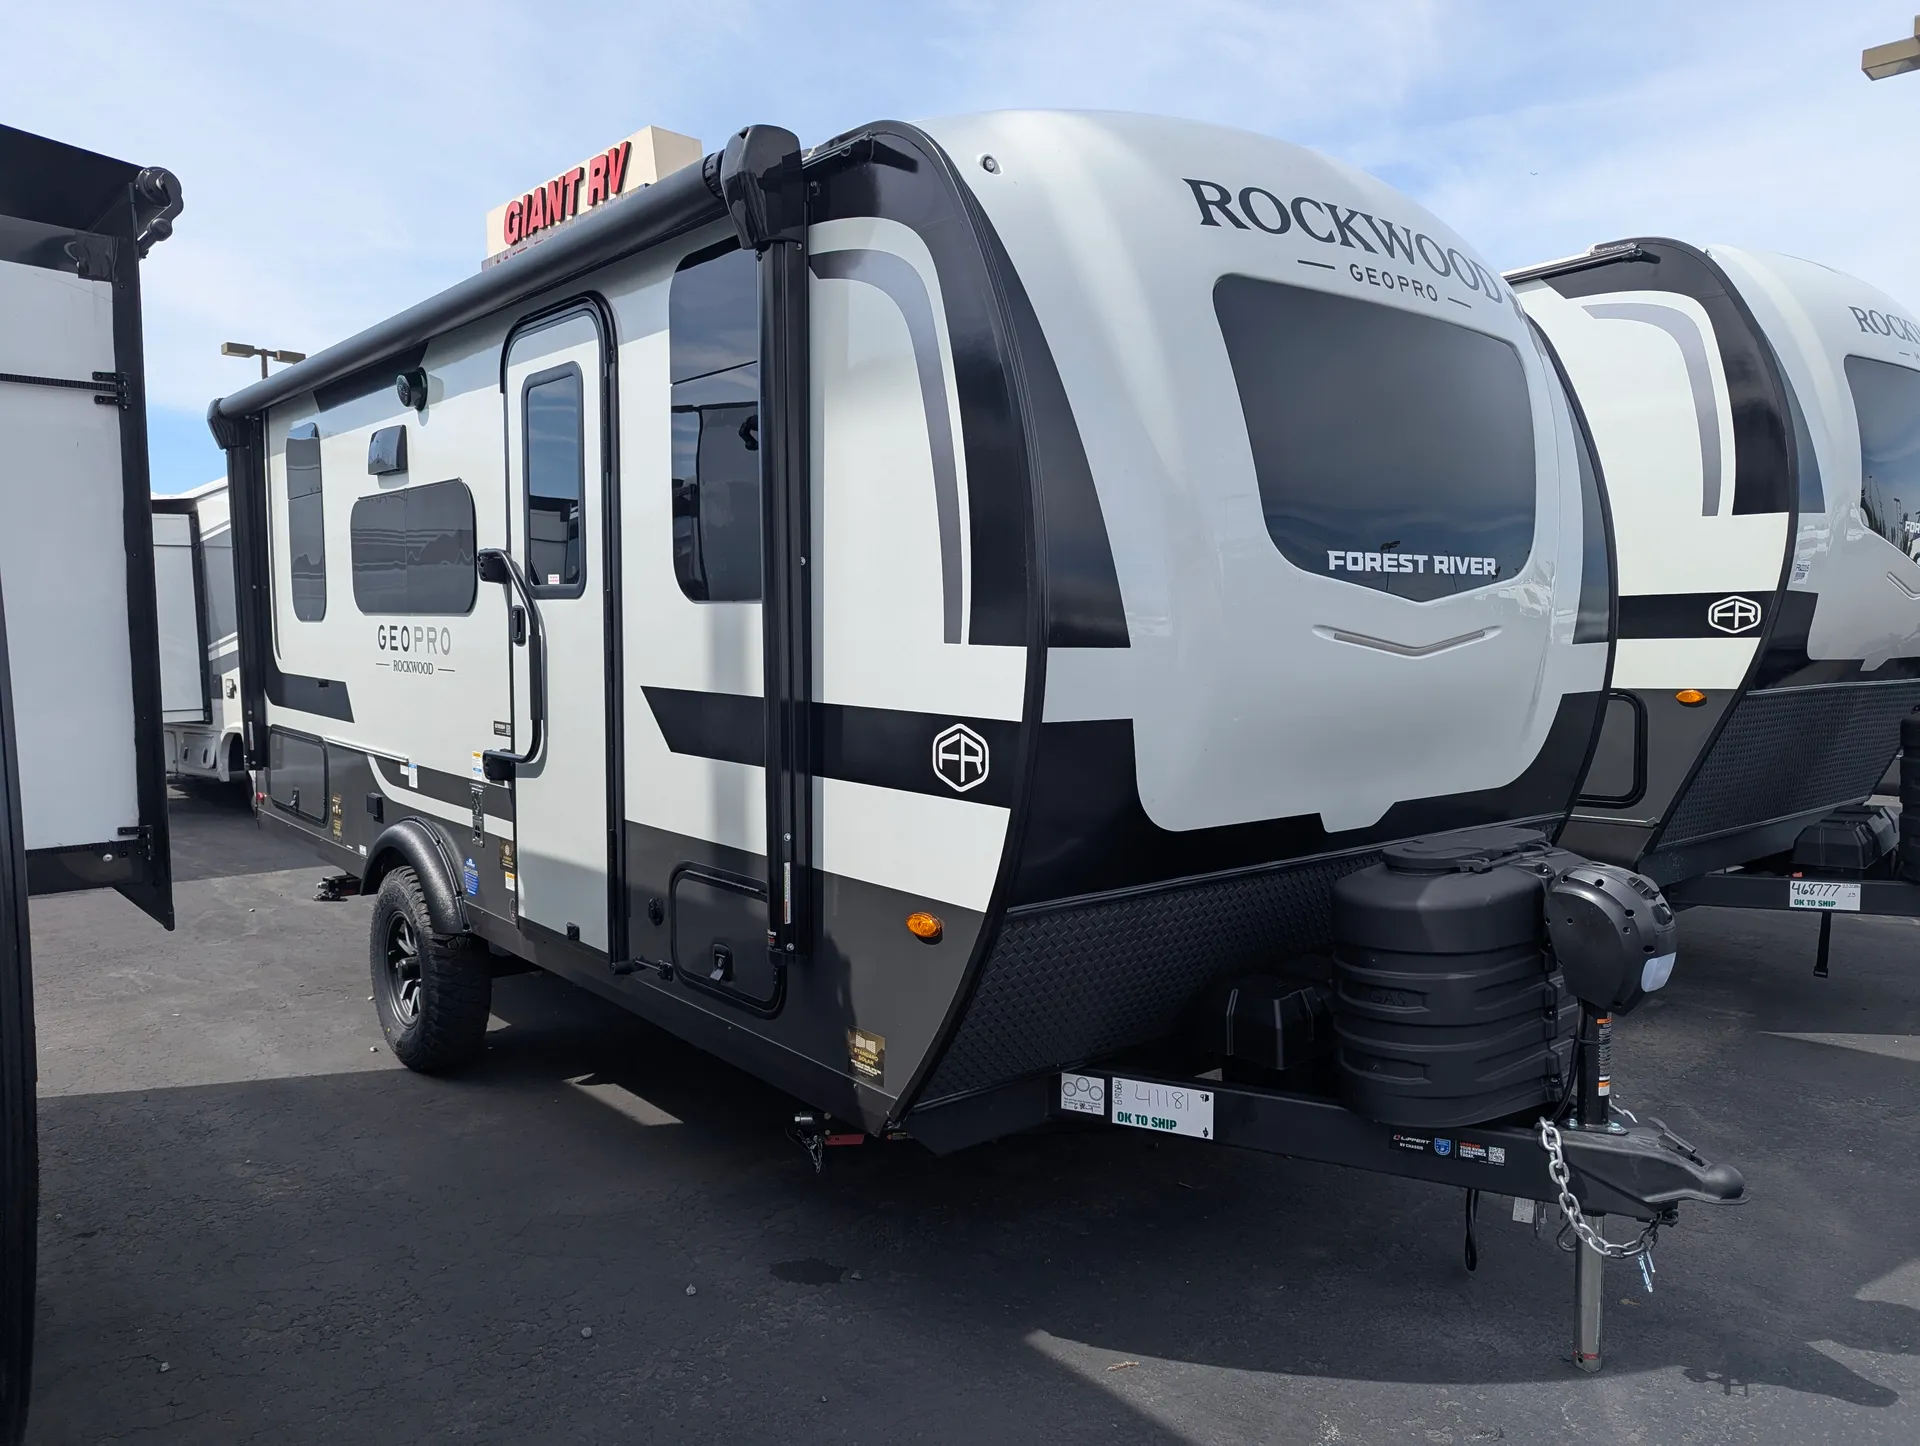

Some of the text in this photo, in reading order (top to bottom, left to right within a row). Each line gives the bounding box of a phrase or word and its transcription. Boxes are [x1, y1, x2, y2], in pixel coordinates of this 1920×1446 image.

[504, 141, 631, 245] GIANT RV
[1181, 178, 1503, 304] ROCKWOOD
[1349, 263, 1438, 302] GEOPRO
[1327, 550, 1496, 576] FOREST RIVER
[377, 624, 451, 656] GEOPRO
[393, 660, 434, 675] ROCKWOOD
[1791, 882, 1842, 897] 468777
[1818, 900, 1837, 908] SHIP
[1135, 1084, 1188, 1112] 41181
[1117, 1111, 1177, 1130] OK TO SHIP
